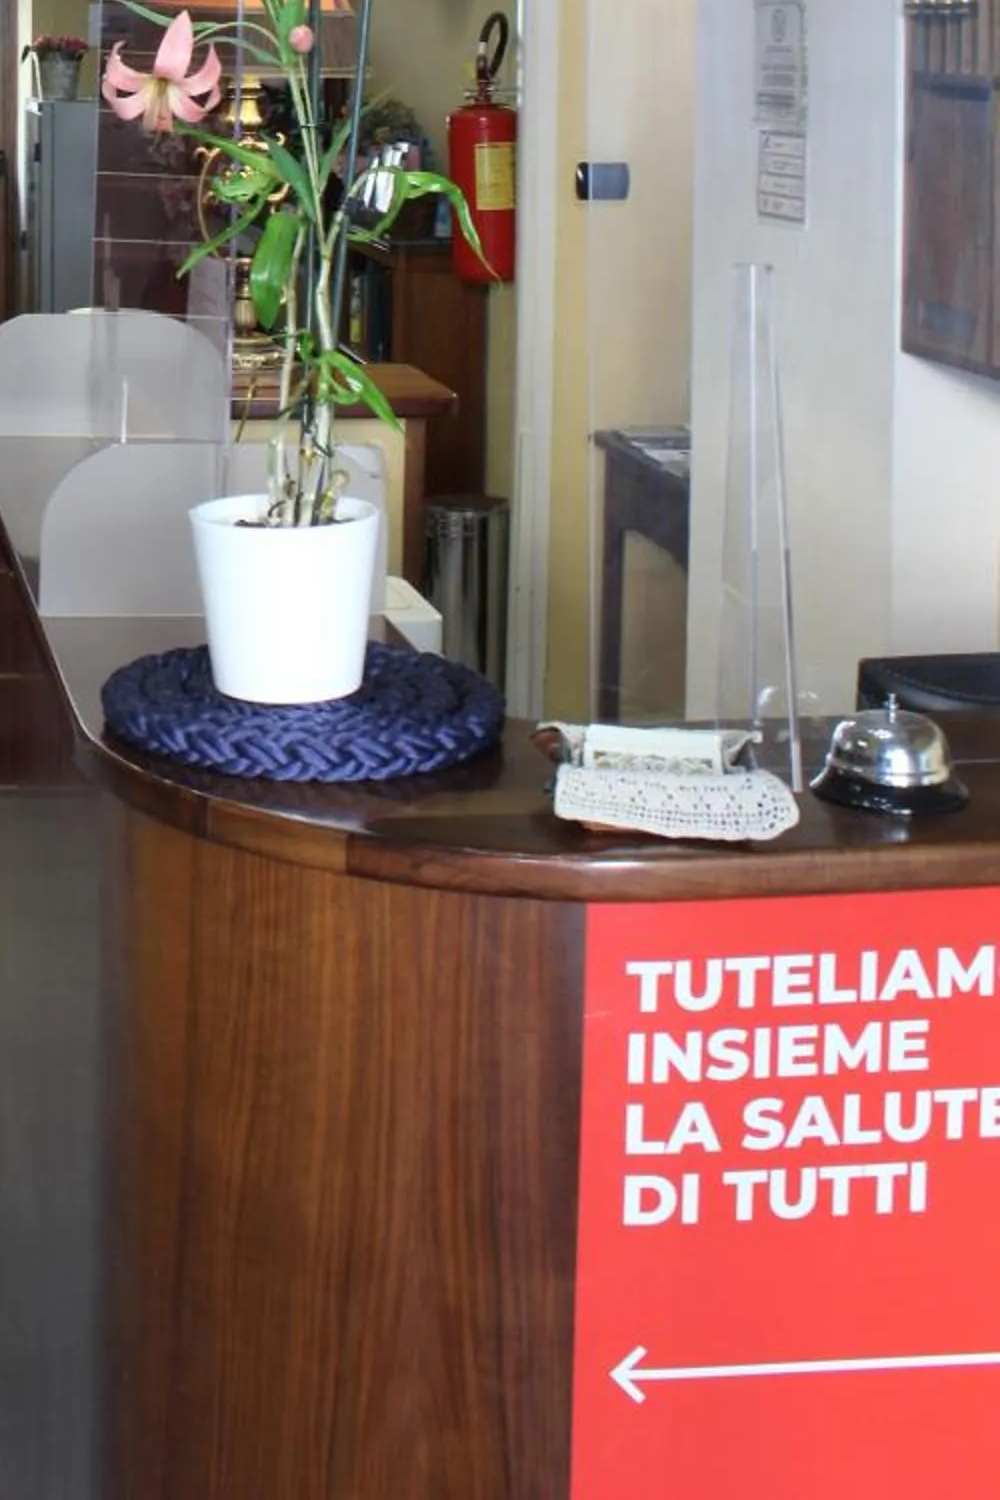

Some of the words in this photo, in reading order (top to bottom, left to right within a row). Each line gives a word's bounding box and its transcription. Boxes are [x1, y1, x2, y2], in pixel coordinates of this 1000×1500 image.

[625, 945, 1000, 1013] TUTELIAM
[626, 1019, 930, 1085] INSIEME
[624, 1101, 721, 1155] LA
[623, 1173, 700, 1227] DI
[722, 1160, 928, 1222] TUTTI
